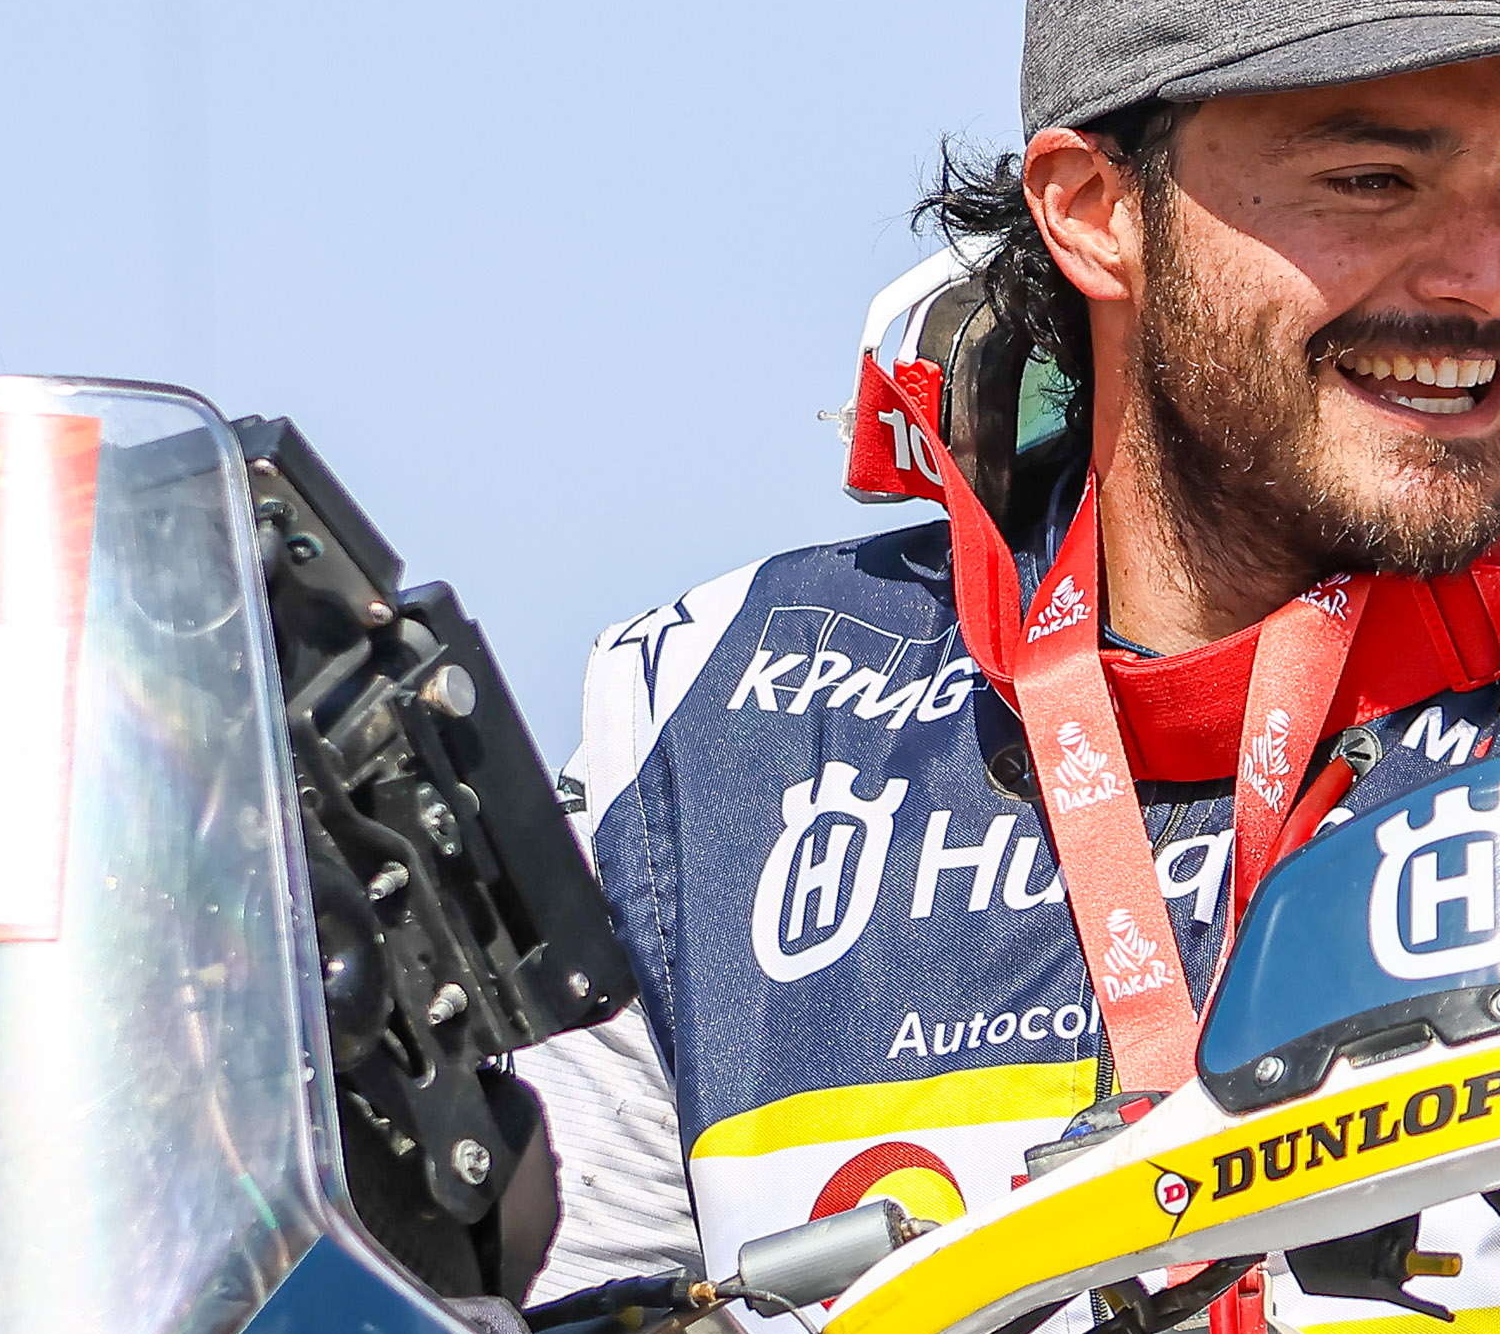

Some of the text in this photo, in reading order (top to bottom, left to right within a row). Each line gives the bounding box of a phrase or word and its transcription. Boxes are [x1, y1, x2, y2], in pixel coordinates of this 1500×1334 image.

[1027, 603, 1090, 643] DAKAR
[726, 650, 974, 730] KPMG
[1054, 777, 1125, 815] DAKAR
[1242, 753, 1284, 814] DAKAR
[1104, 960, 1174, 1004] DAKAR
